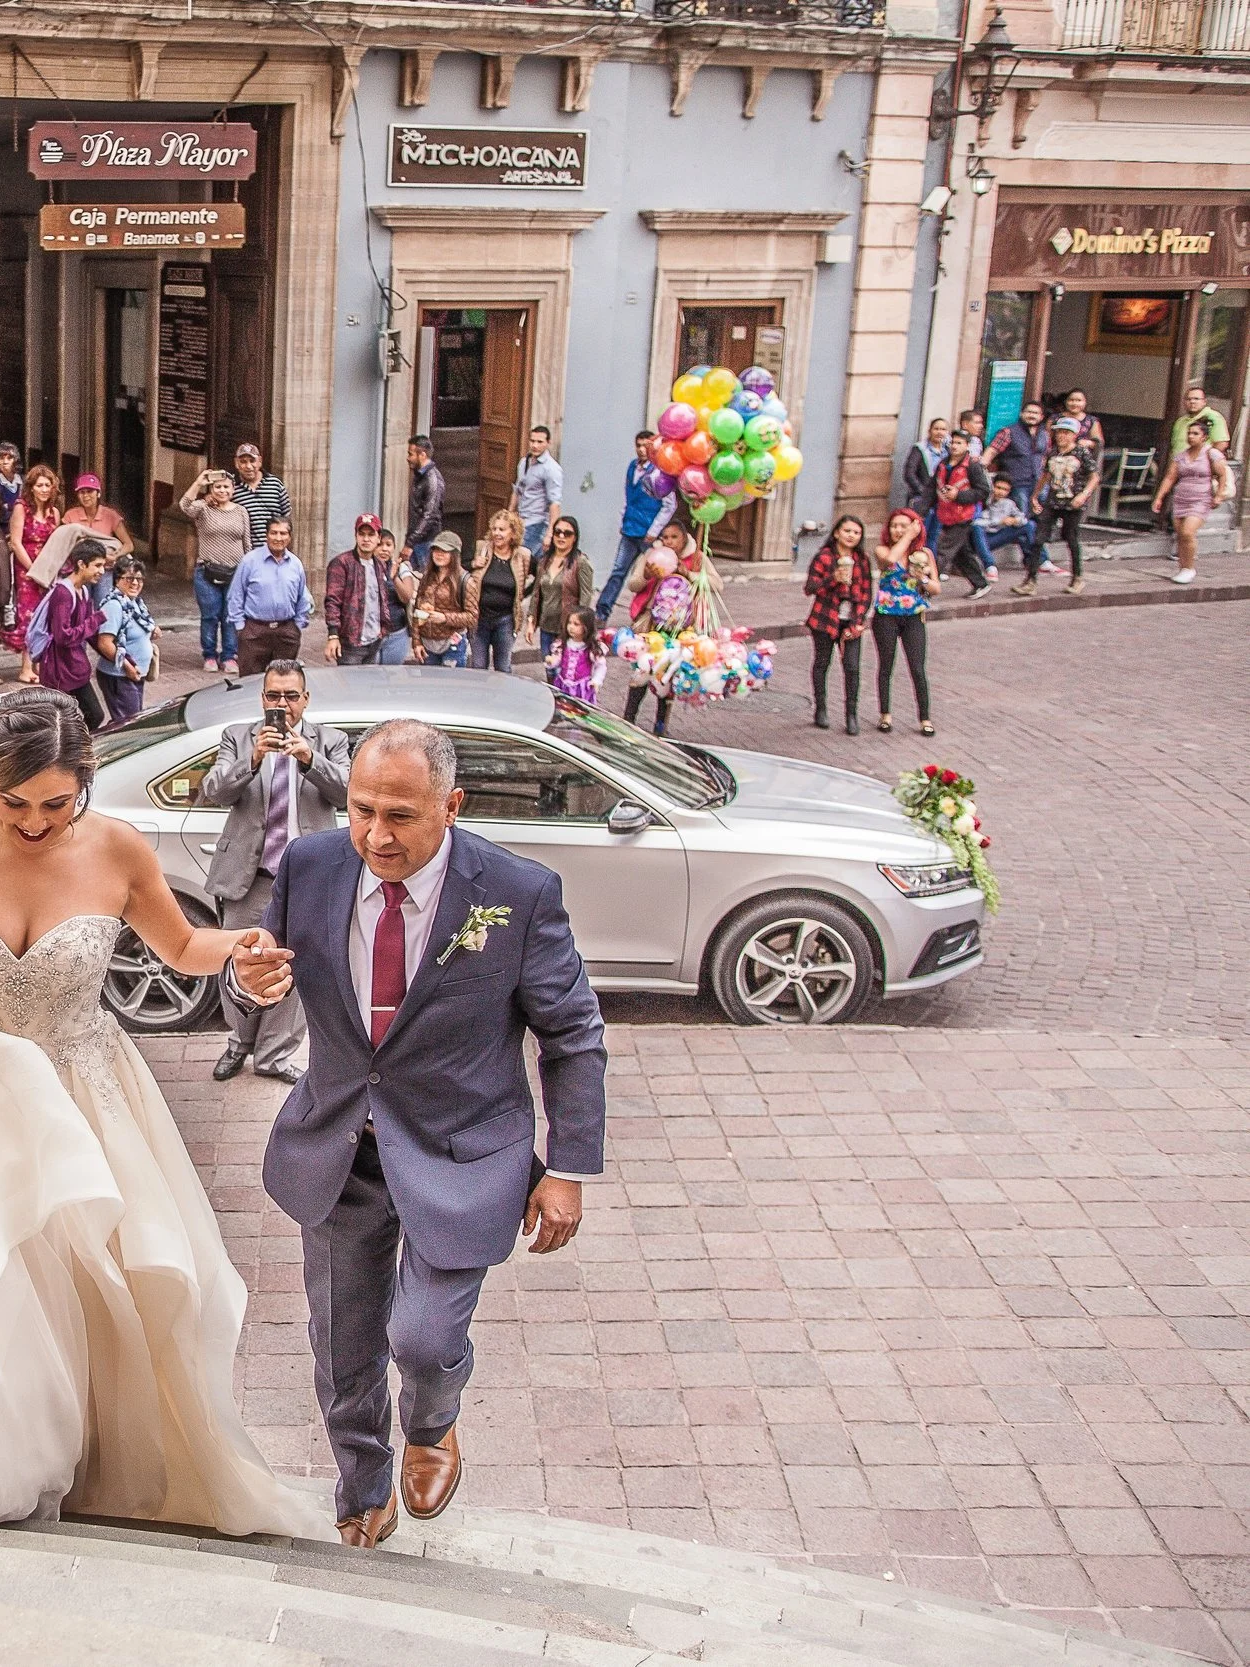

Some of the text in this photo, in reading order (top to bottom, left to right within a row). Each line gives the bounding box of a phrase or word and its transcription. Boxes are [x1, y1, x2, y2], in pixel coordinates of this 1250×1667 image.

[79, 130, 248, 172] Plaza Mayor
[401, 143, 581, 169] MICHOACANA
[69, 208, 219, 228] Caja Permanente
[123, 232, 180, 245] Banamex
[1071, 227, 1212, 254] Domino's Pizza
